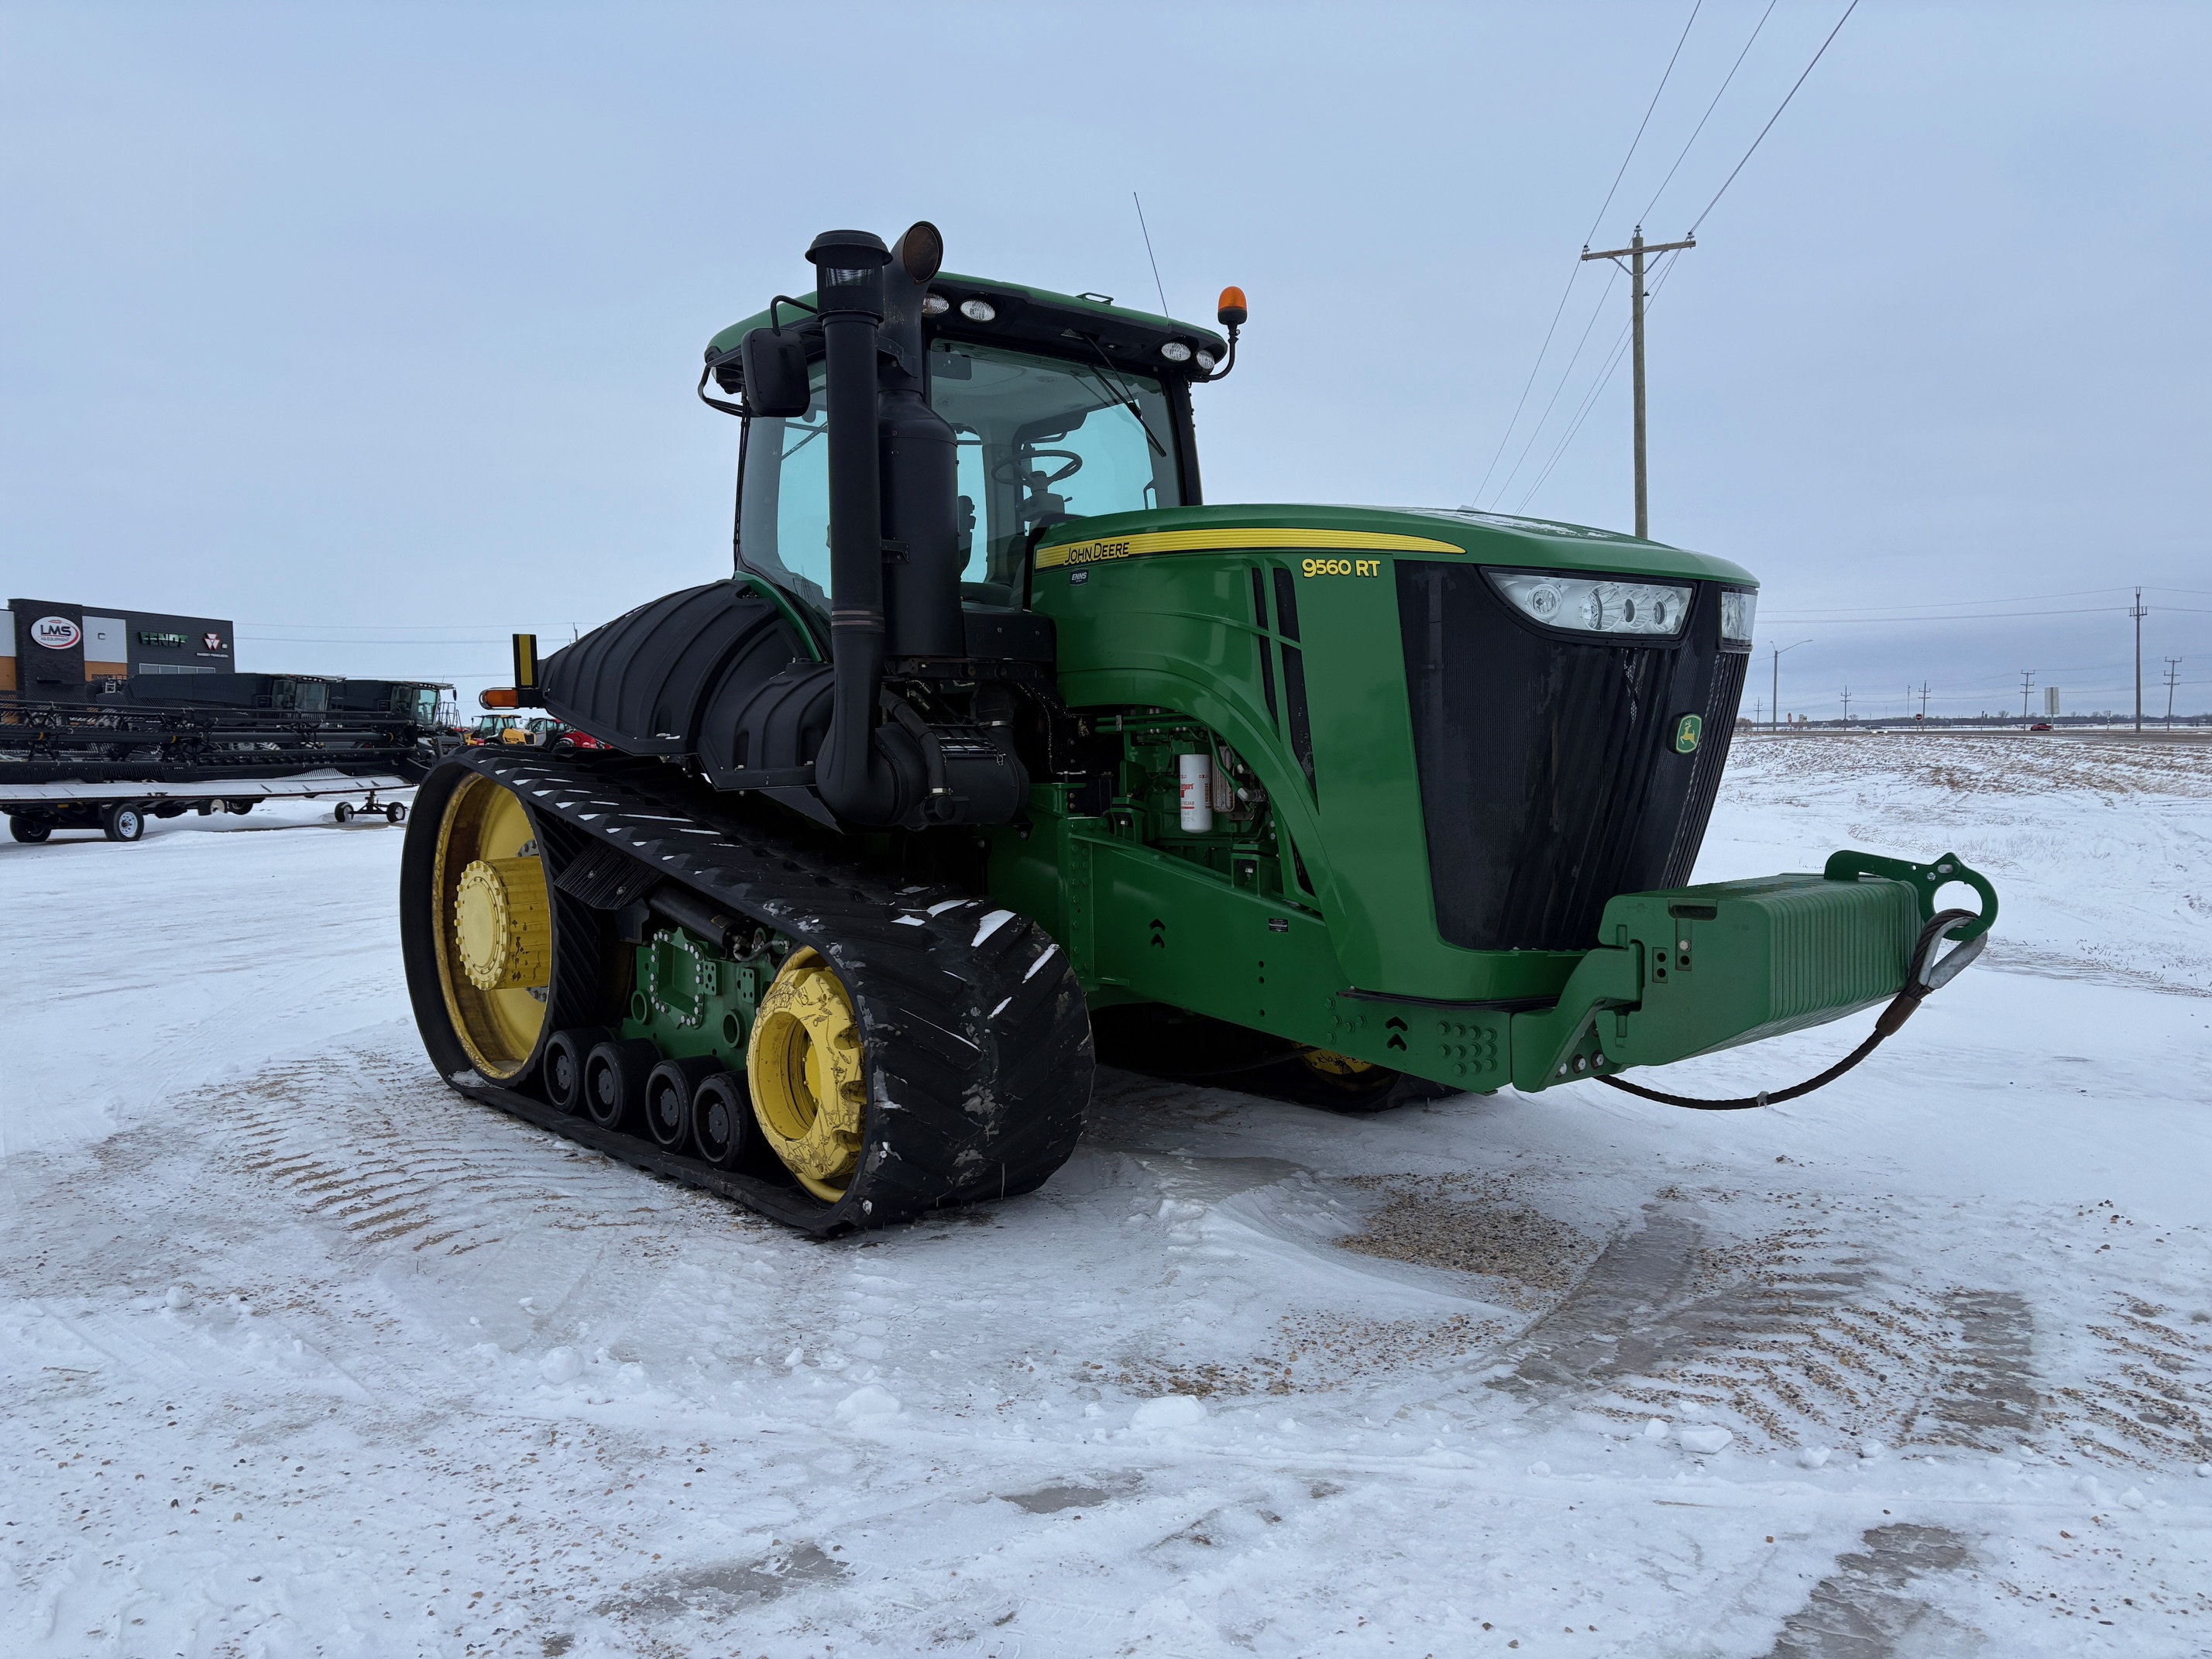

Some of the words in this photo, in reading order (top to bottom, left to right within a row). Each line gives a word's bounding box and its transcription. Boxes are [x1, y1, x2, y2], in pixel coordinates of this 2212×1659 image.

[1064, 546, 1093, 563] JOHN
[1094, 542, 1129, 559] DEERE
[1072, 572, 1087, 580] ENNS
[1301, 558, 1352, 578] 9560
[1355, 559, 1381, 577] RT
[40, 624, 71, 637] LMS
[139, 631, 187, 647] FENDT
